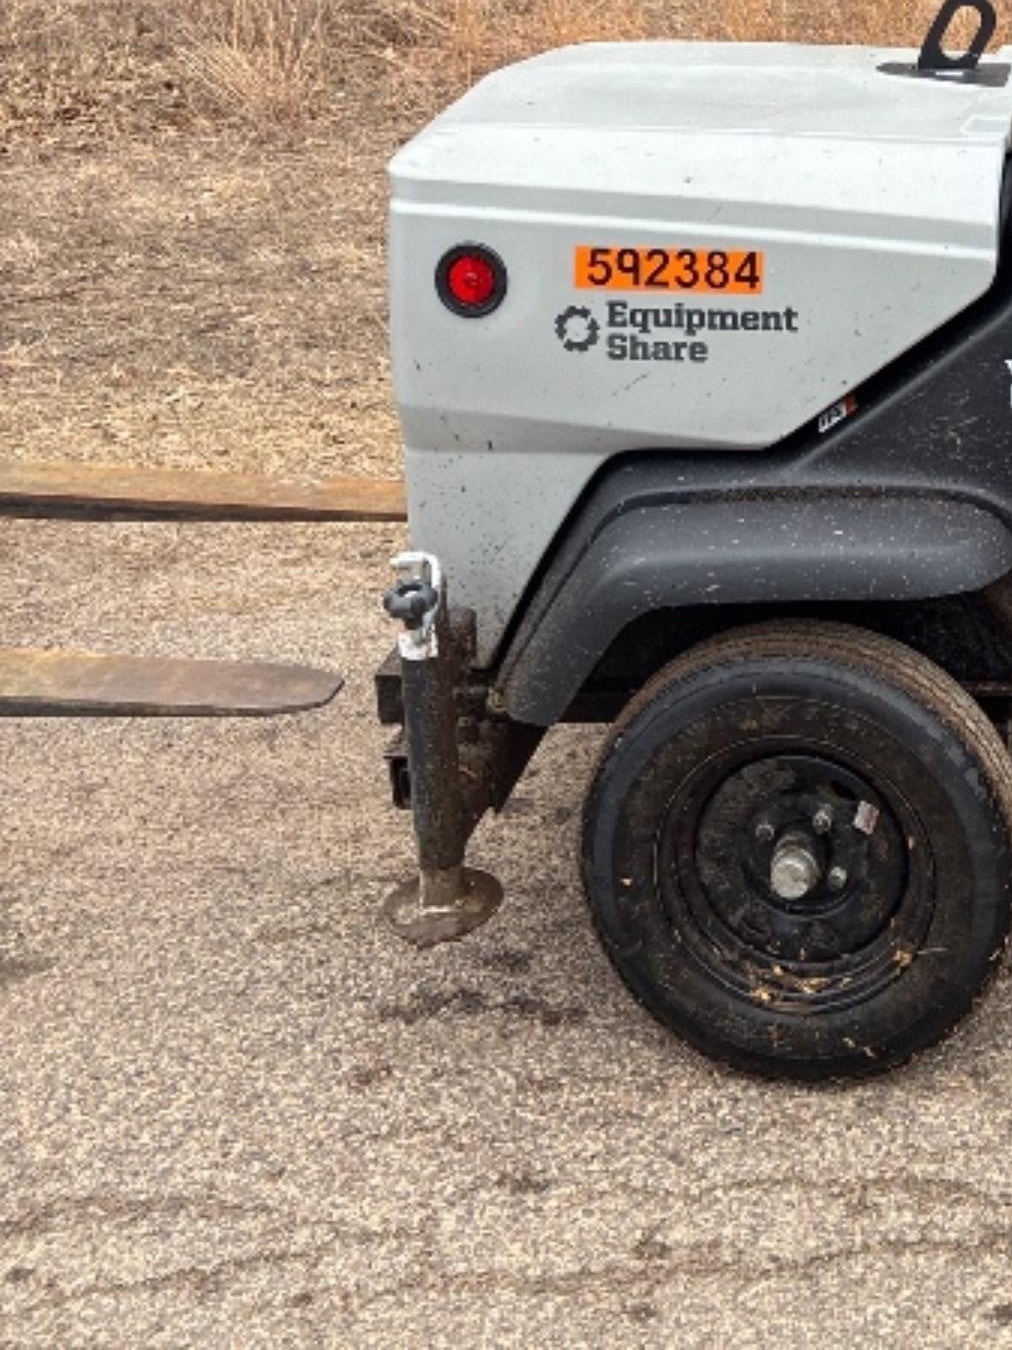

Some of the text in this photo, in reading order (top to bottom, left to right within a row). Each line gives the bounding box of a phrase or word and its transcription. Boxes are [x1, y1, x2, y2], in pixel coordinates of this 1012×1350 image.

[587, 248, 761, 289] 592384
[606, 300, 798, 336] Equipment
[606, 333, 708, 363] Share
